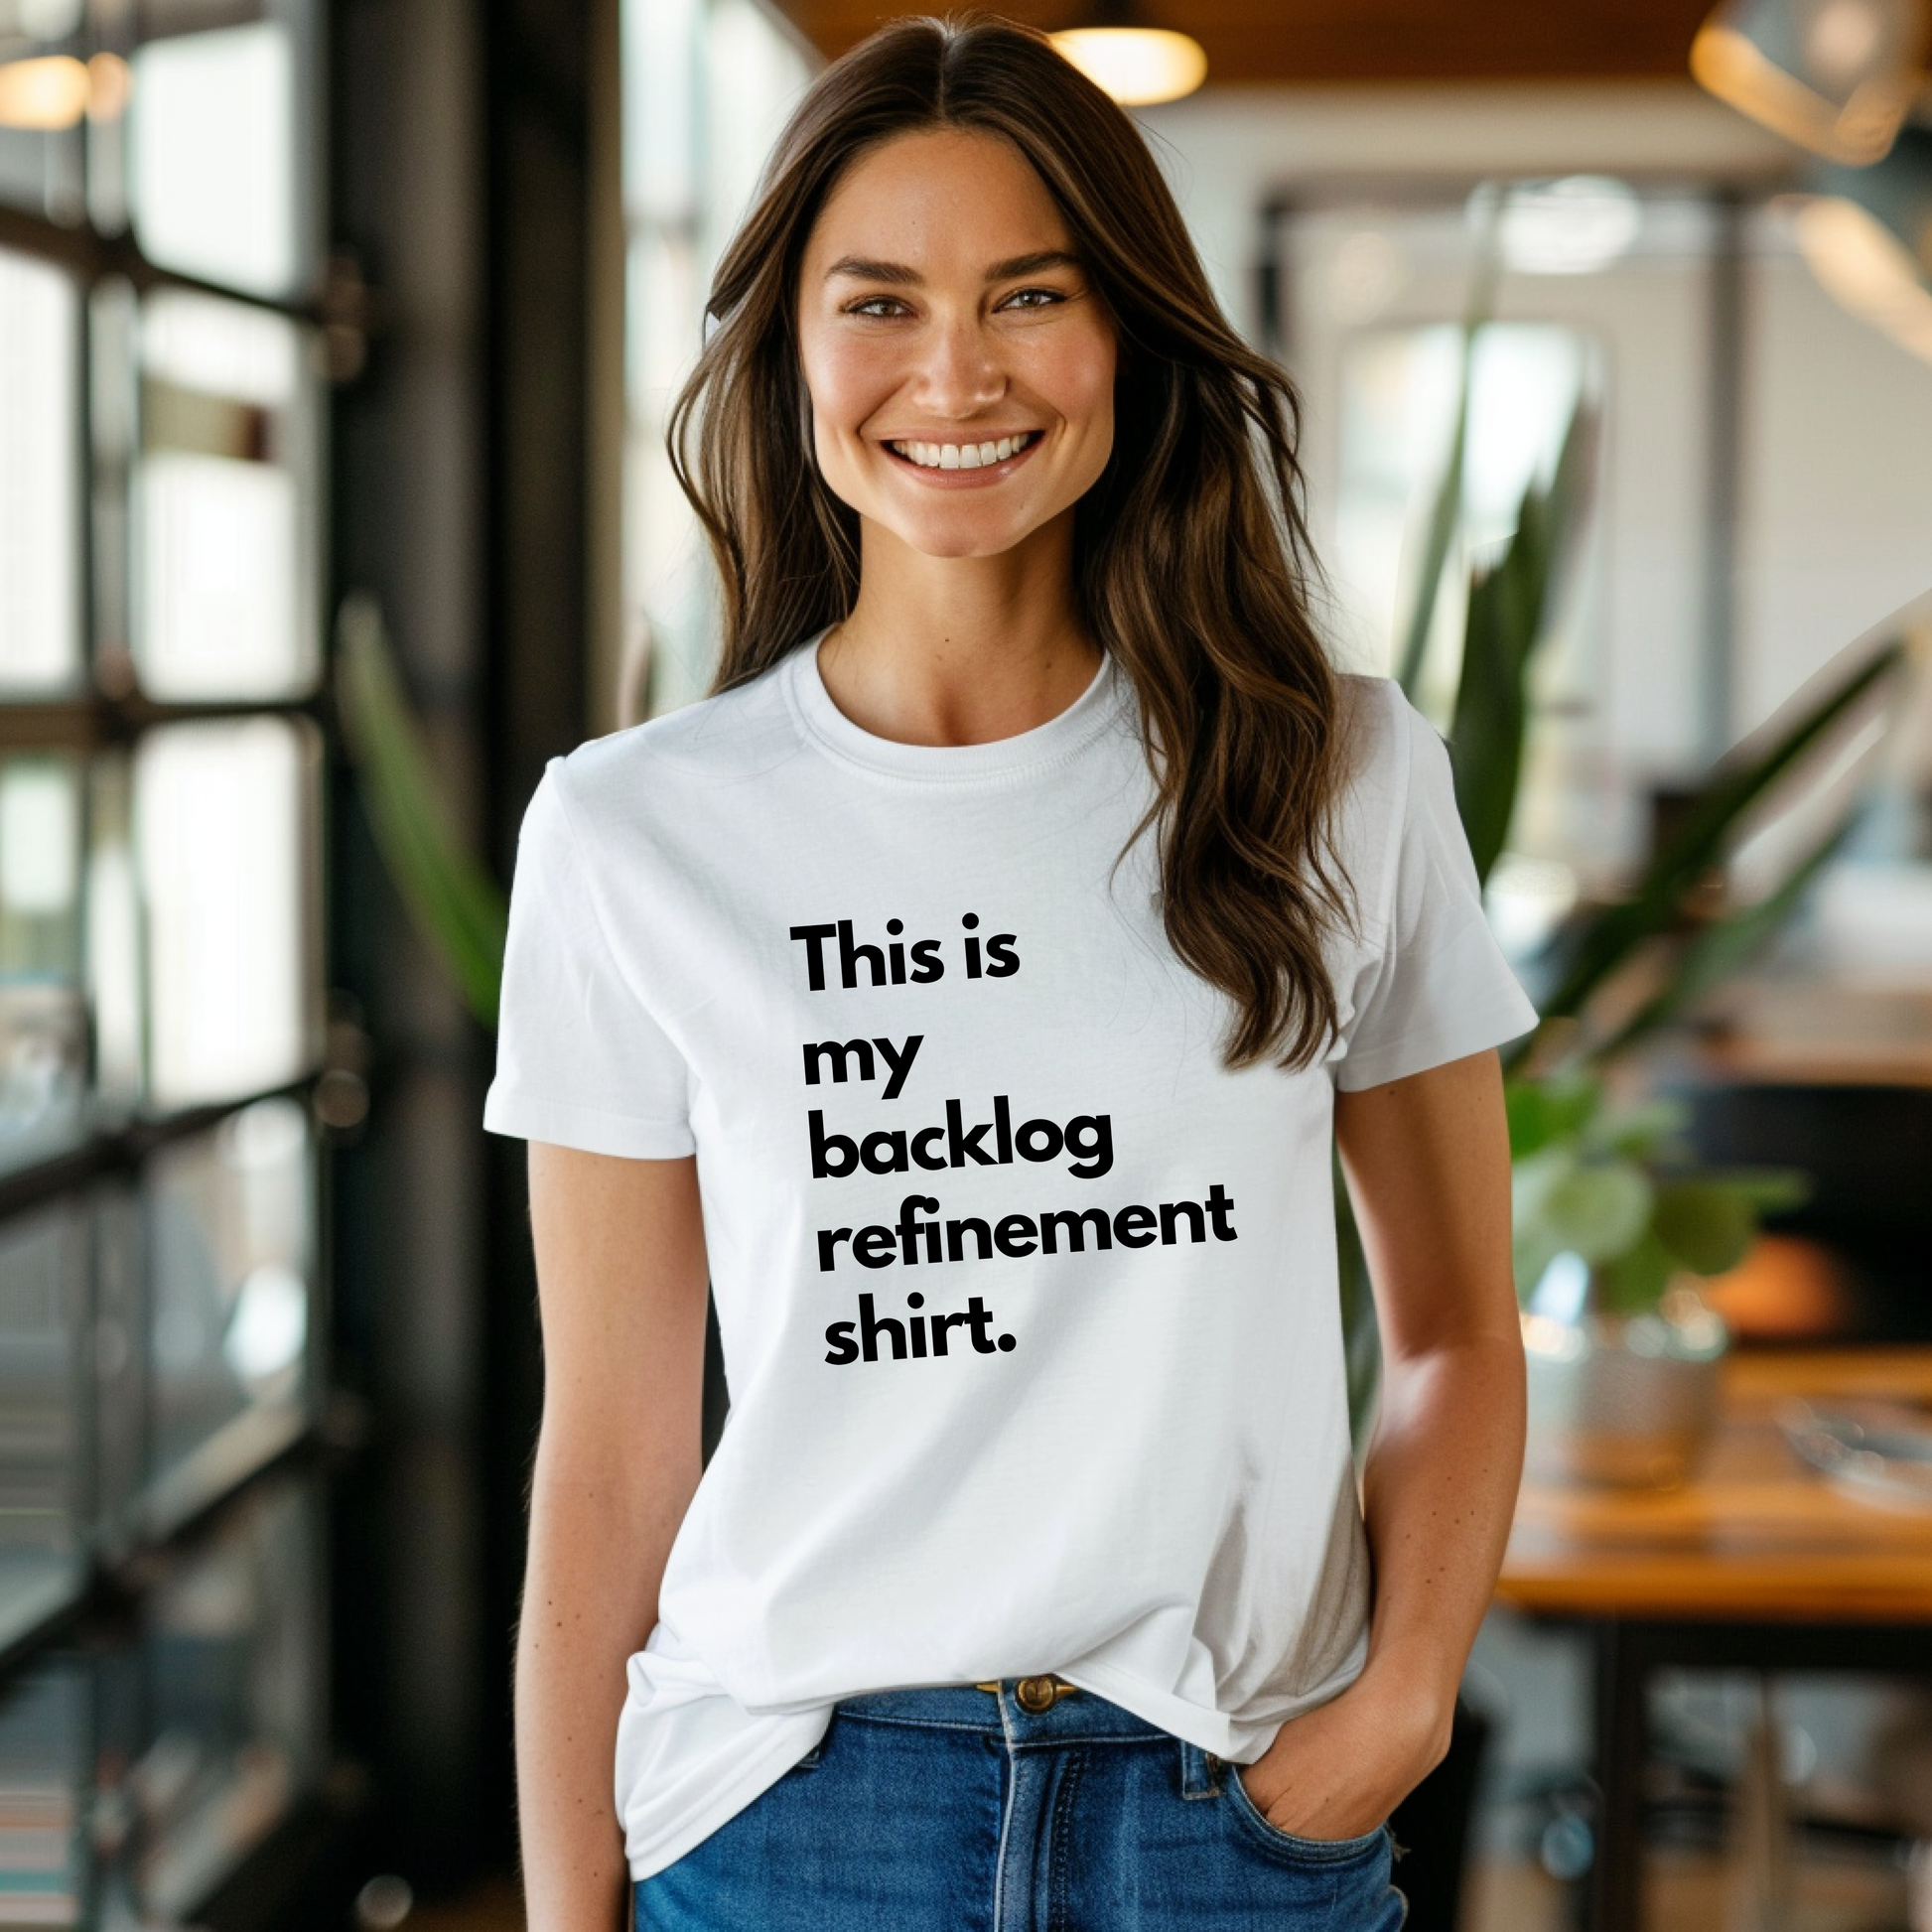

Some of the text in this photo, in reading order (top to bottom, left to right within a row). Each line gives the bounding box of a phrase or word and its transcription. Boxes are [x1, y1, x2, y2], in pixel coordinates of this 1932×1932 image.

[789, 912, 1021, 992] This is
[802, 1035, 925, 1100] my
[807, 1094, 1114, 1179] backlog
[817, 1183, 1239, 1273] refinement
[824, 1292, 1017, 1366] shirt.
